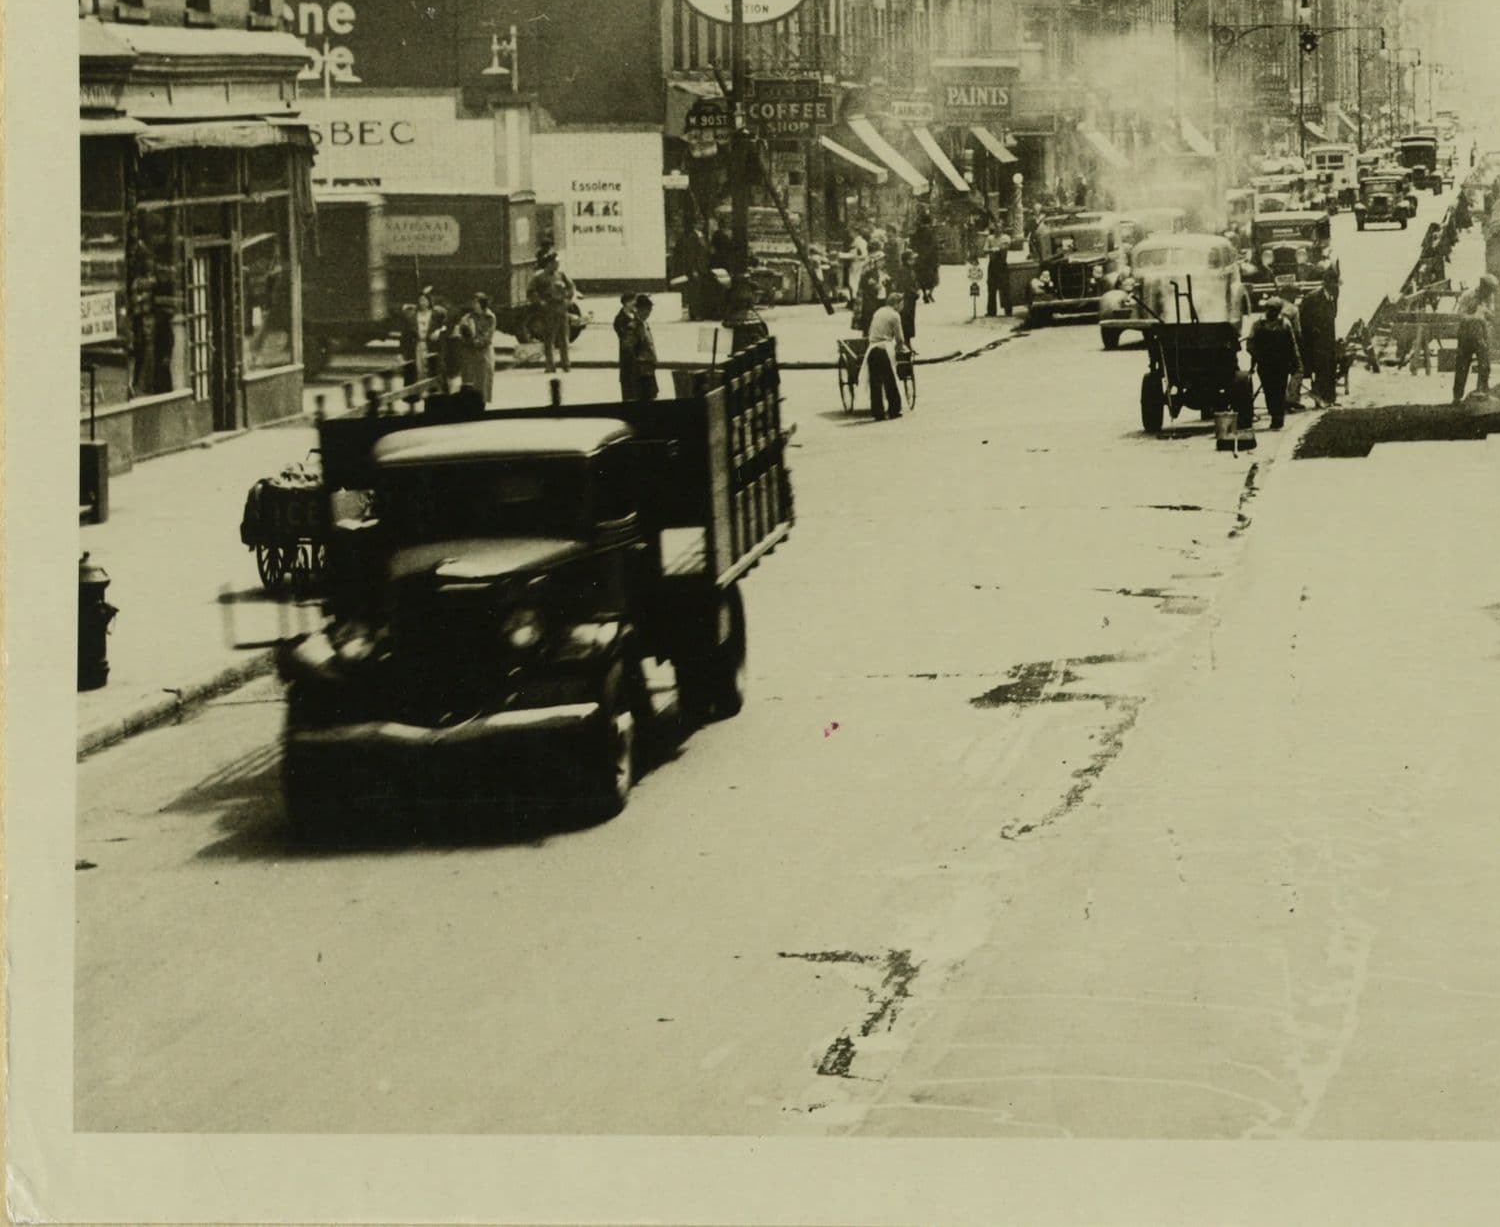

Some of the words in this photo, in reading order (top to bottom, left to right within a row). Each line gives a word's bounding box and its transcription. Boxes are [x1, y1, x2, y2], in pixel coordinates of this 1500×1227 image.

[724, 5, 769, 14] STION
[282, 2, 356, 35] ne
[947, 86, 1009, 106] PAINTS
[749, 102, 827, 119] COFFEE
[767, 121, 810, 133] SHOP
[571, 179, 622, 193] Essolene
